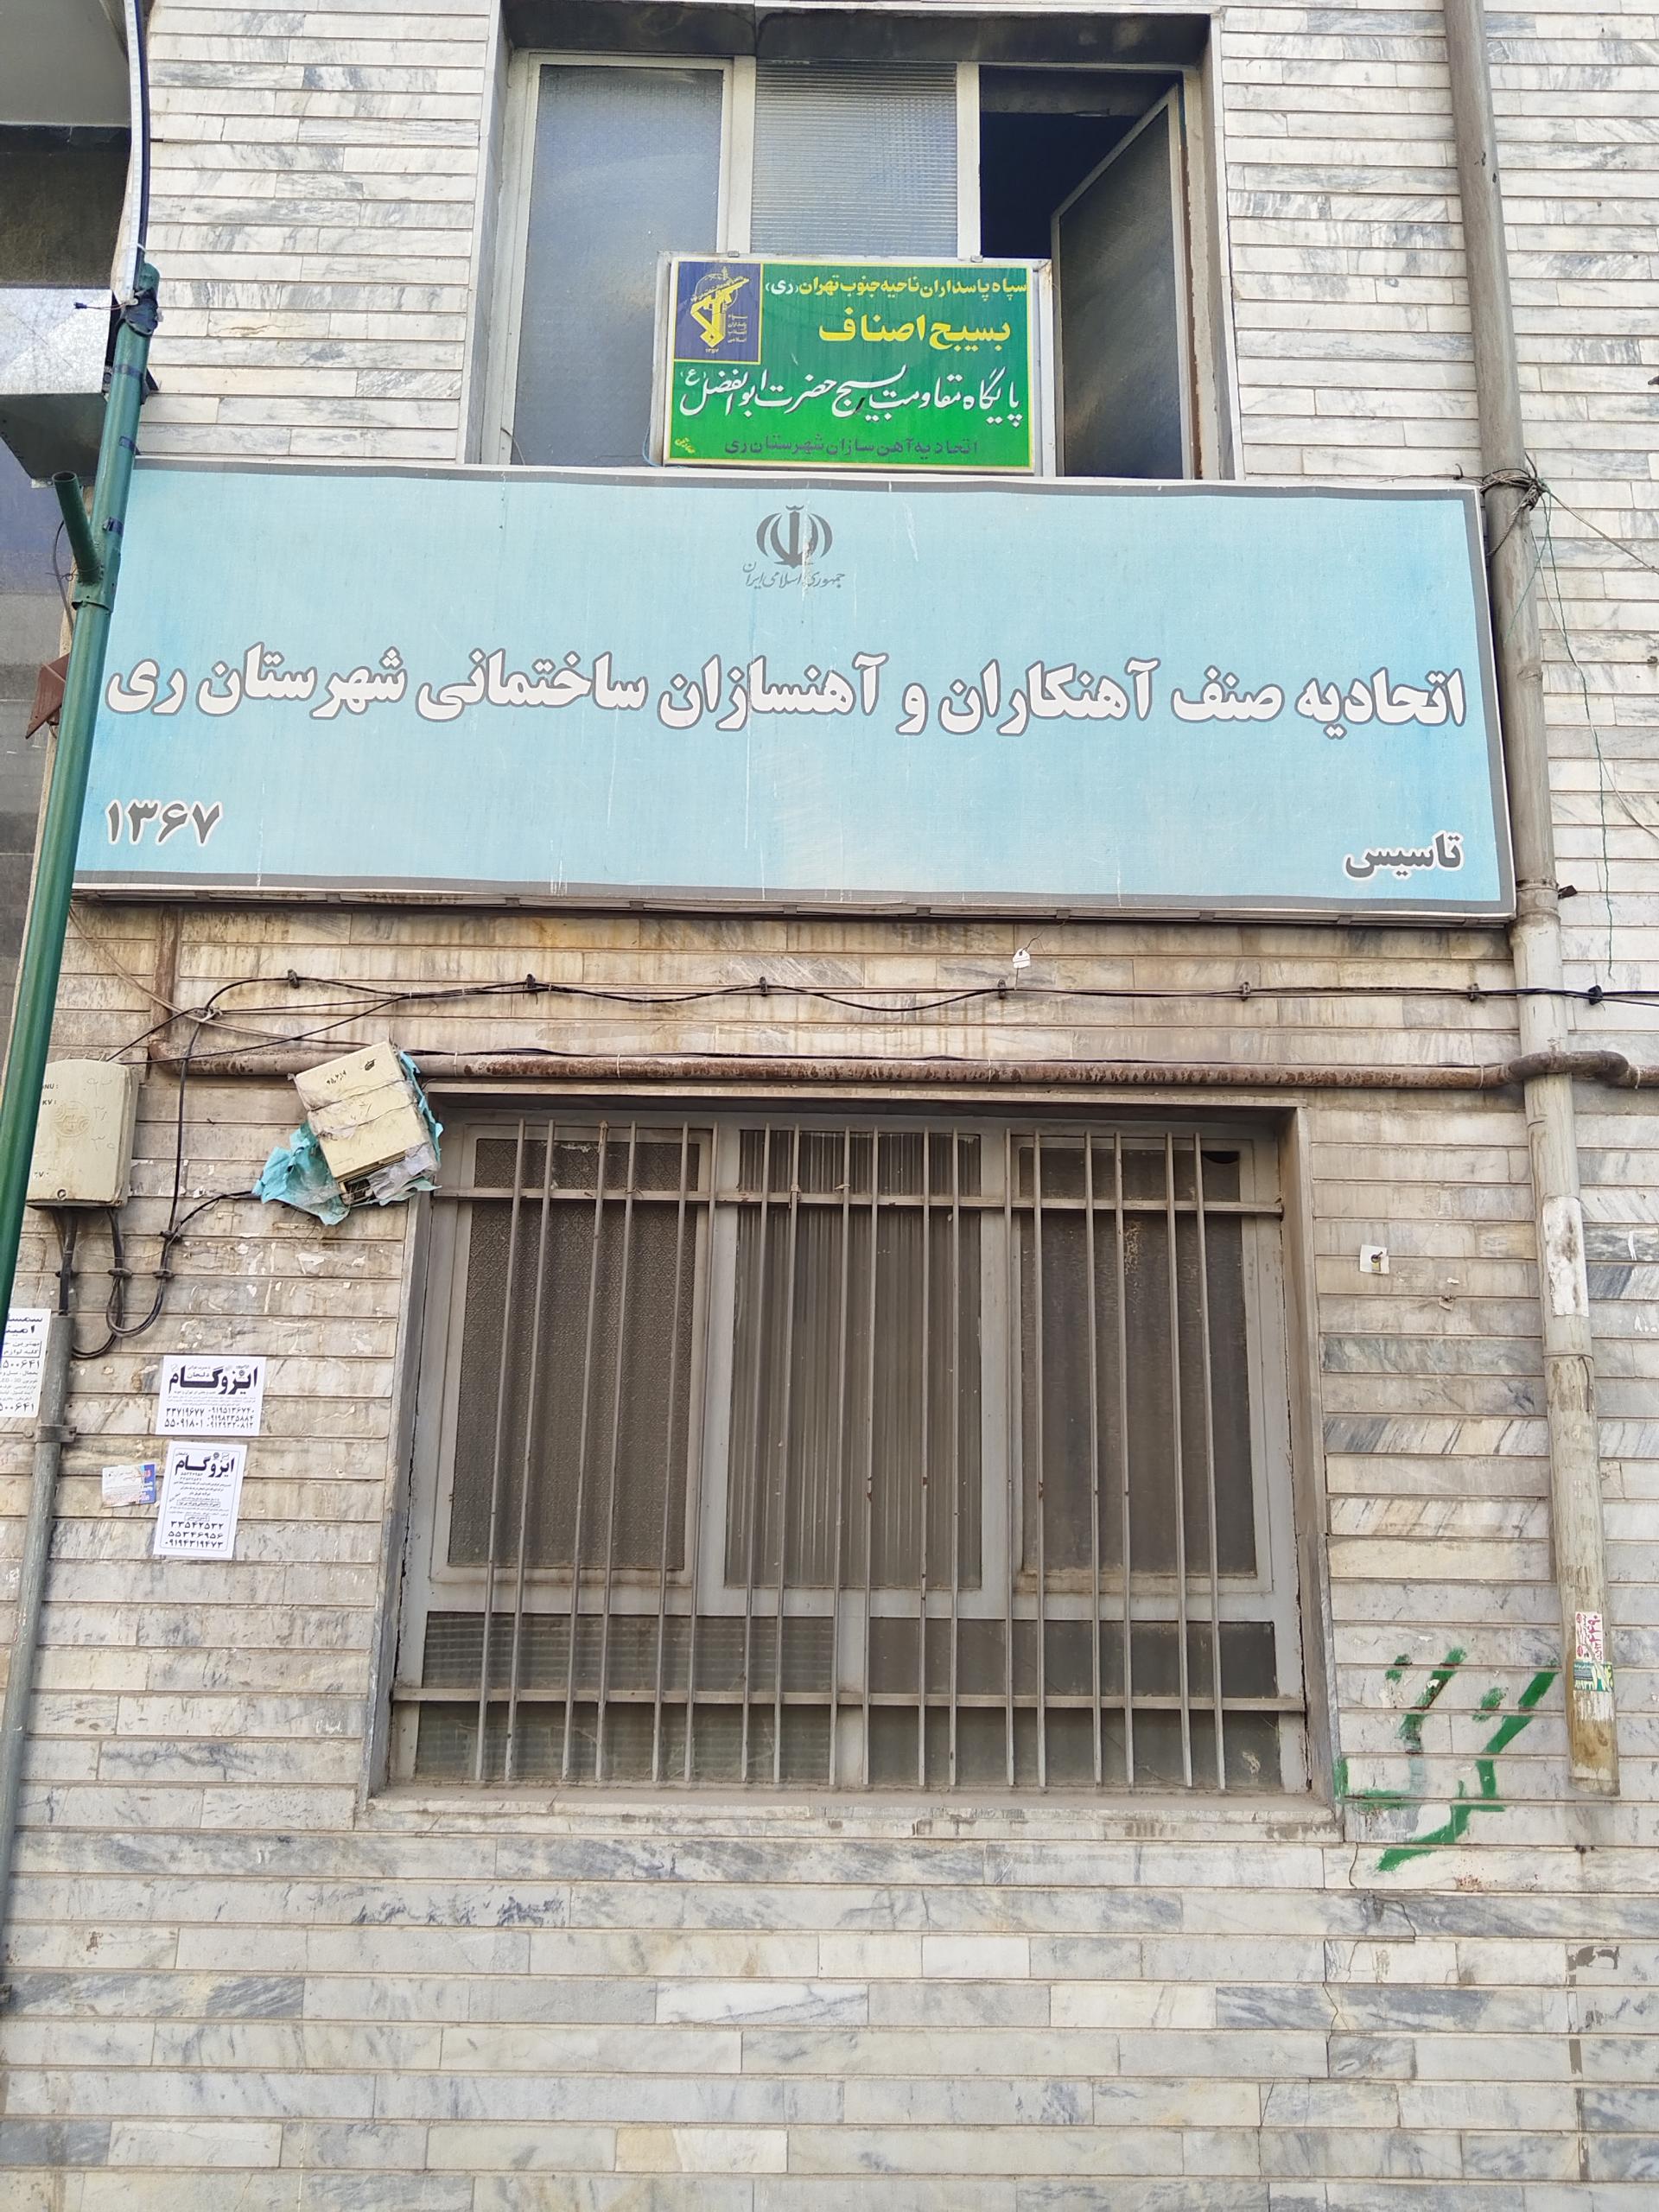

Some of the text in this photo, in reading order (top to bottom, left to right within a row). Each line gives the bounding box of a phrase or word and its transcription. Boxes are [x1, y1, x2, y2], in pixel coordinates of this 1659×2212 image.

[798, 274, 840, 296] تهران
[840, 276, 880, 298] جنوب
[880, 276, 919, 298] ناحیه
[920, 277, 991, 301] پاسداران
[993, 277, 1027, 301] سپاه
[818, 306, 1011, 352] بسیج اصناف
[679, 369, 768, 418] ابوالفضل
[753, 374, 837, 415] حضرت
[831, 364, 907, 422] بسیج
[868, 373, 963, 410] مقاومت
[963, 365, 1024, 427] پایگاه
[725, 434, 977, 460] اتحادیه آهن سازان شهرستان ری
[743, 562, 846, 589] جمهوری اسلامی ایران
[105, 641, 1467, 740] اتحادیه صنف آهنکاران و آهنسازان ساختمانی شهرستان ری
[105, 798, 224, 847] ۱۳۶۷
[1343, 830, 1465, 880] تاسیس
[6, 1325, 35, 1336] امین
[2, 1359, 40, 1369] ۵۰۰۶۴۱
[168, 1364, 258, 1395] ایزوگام
[164, 1418, 203, 1427] ۵۵۰۹۱۸۰۱
[175, 1454, 235, 1478] ایزوگام
